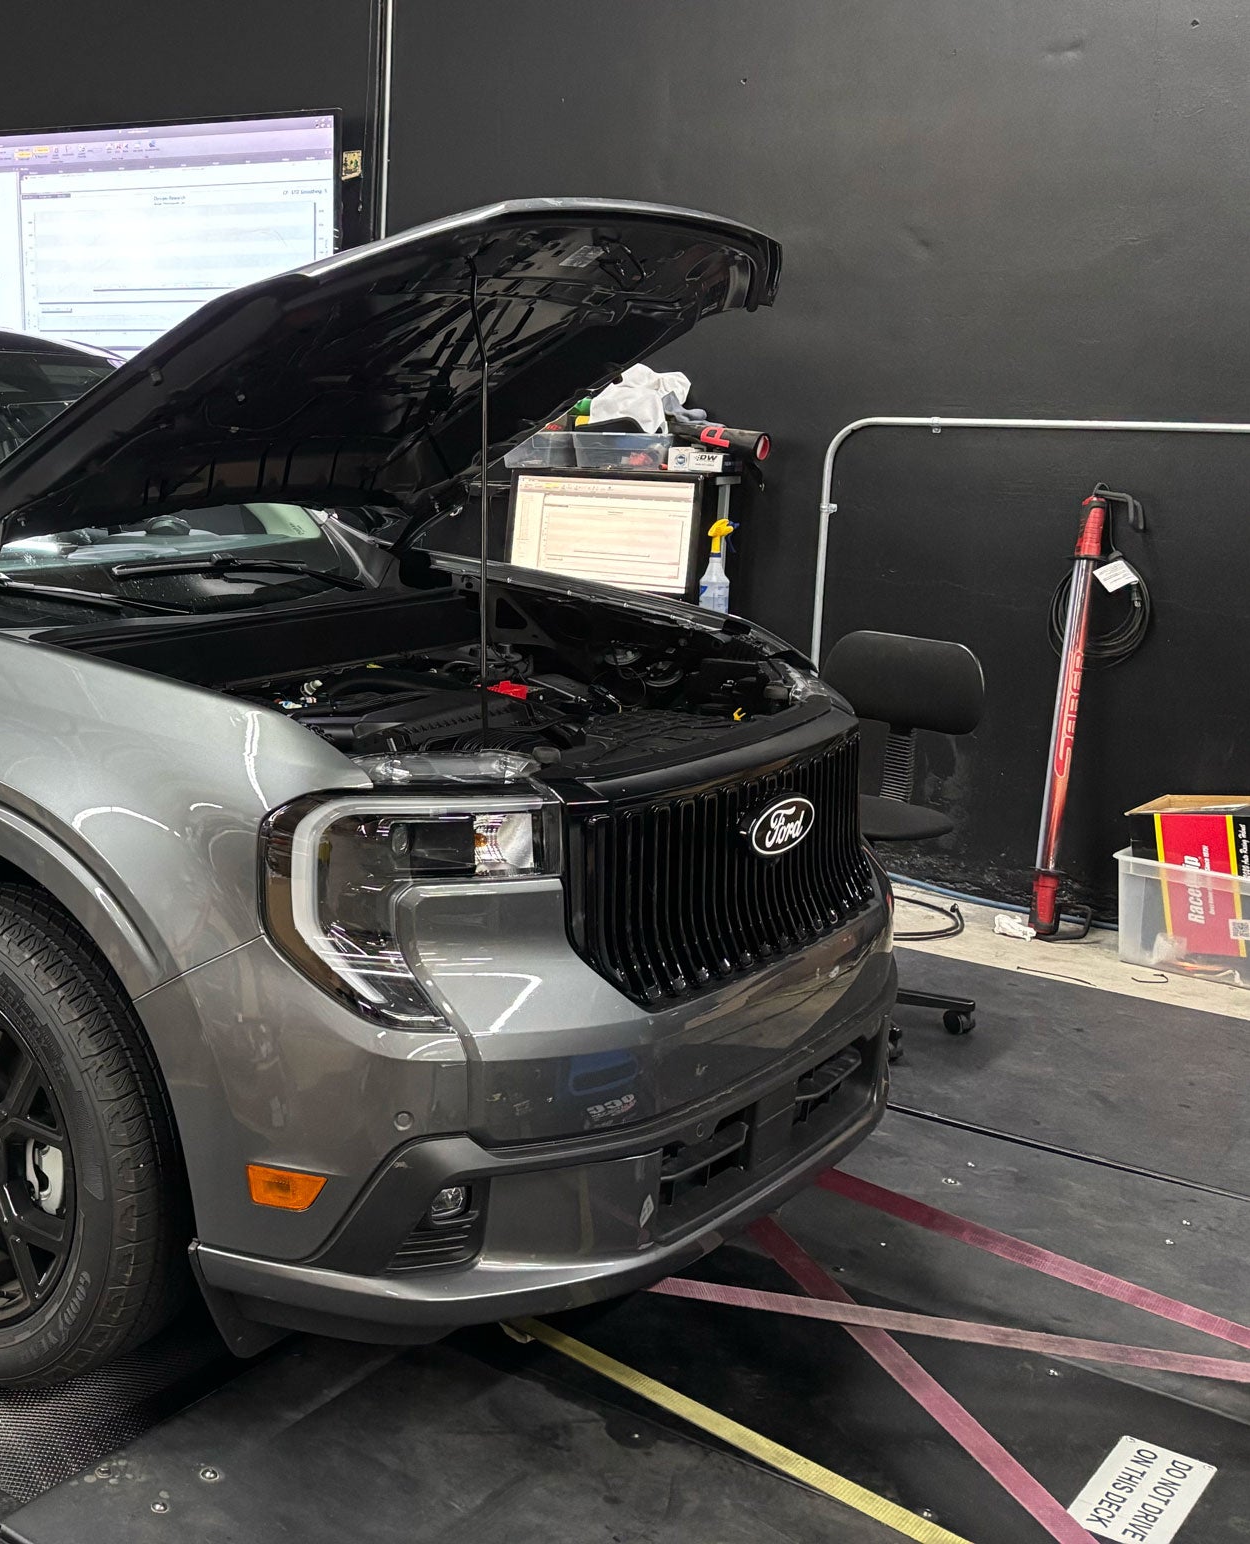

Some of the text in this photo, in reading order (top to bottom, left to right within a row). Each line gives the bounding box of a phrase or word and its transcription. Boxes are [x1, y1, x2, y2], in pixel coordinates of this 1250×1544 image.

[765, 805, 805, 848] Ford
[1085, 1448, 1158, 1528] ON THIS DECK
[1121, 1459, 1194, 1542] DO NOT DRIVE
